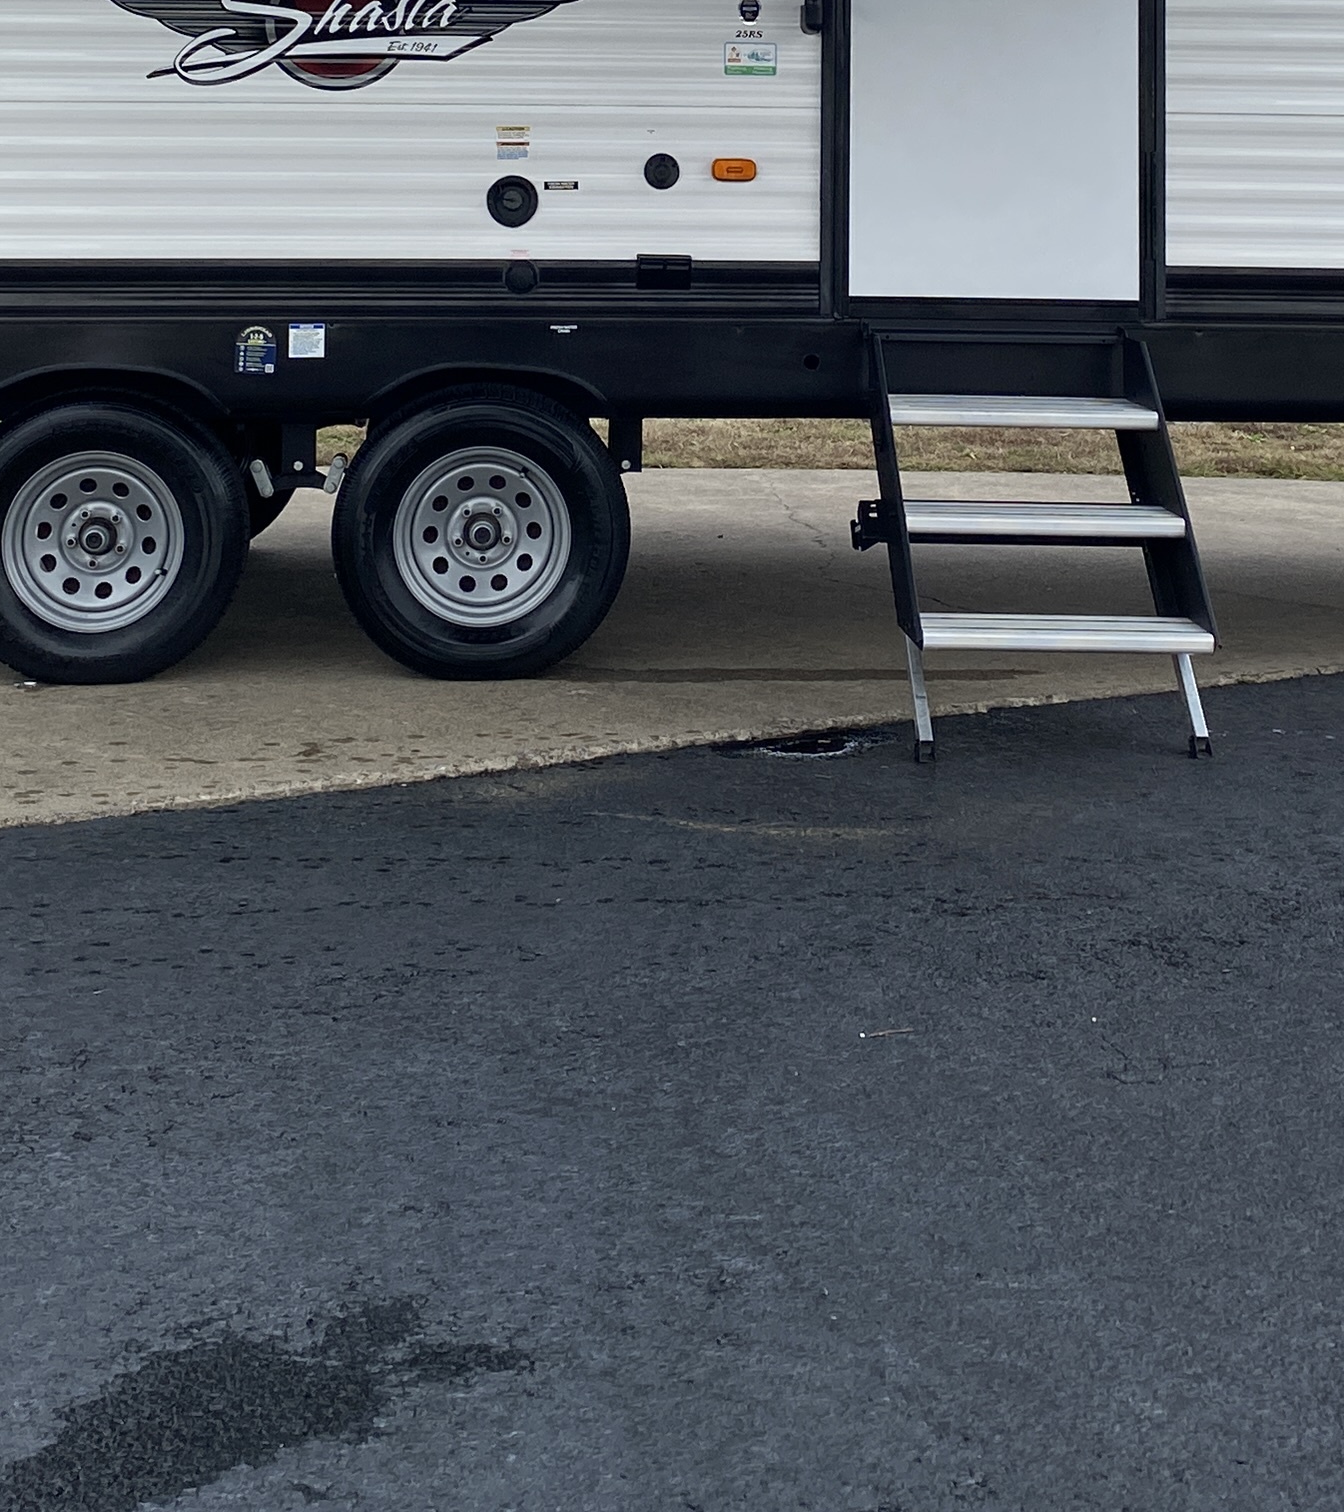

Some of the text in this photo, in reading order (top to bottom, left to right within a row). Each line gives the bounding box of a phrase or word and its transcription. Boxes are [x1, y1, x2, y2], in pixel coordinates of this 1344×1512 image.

[735, 30, 763, 38] 25RS
[387, 40, 438, 53] Est. 1941
